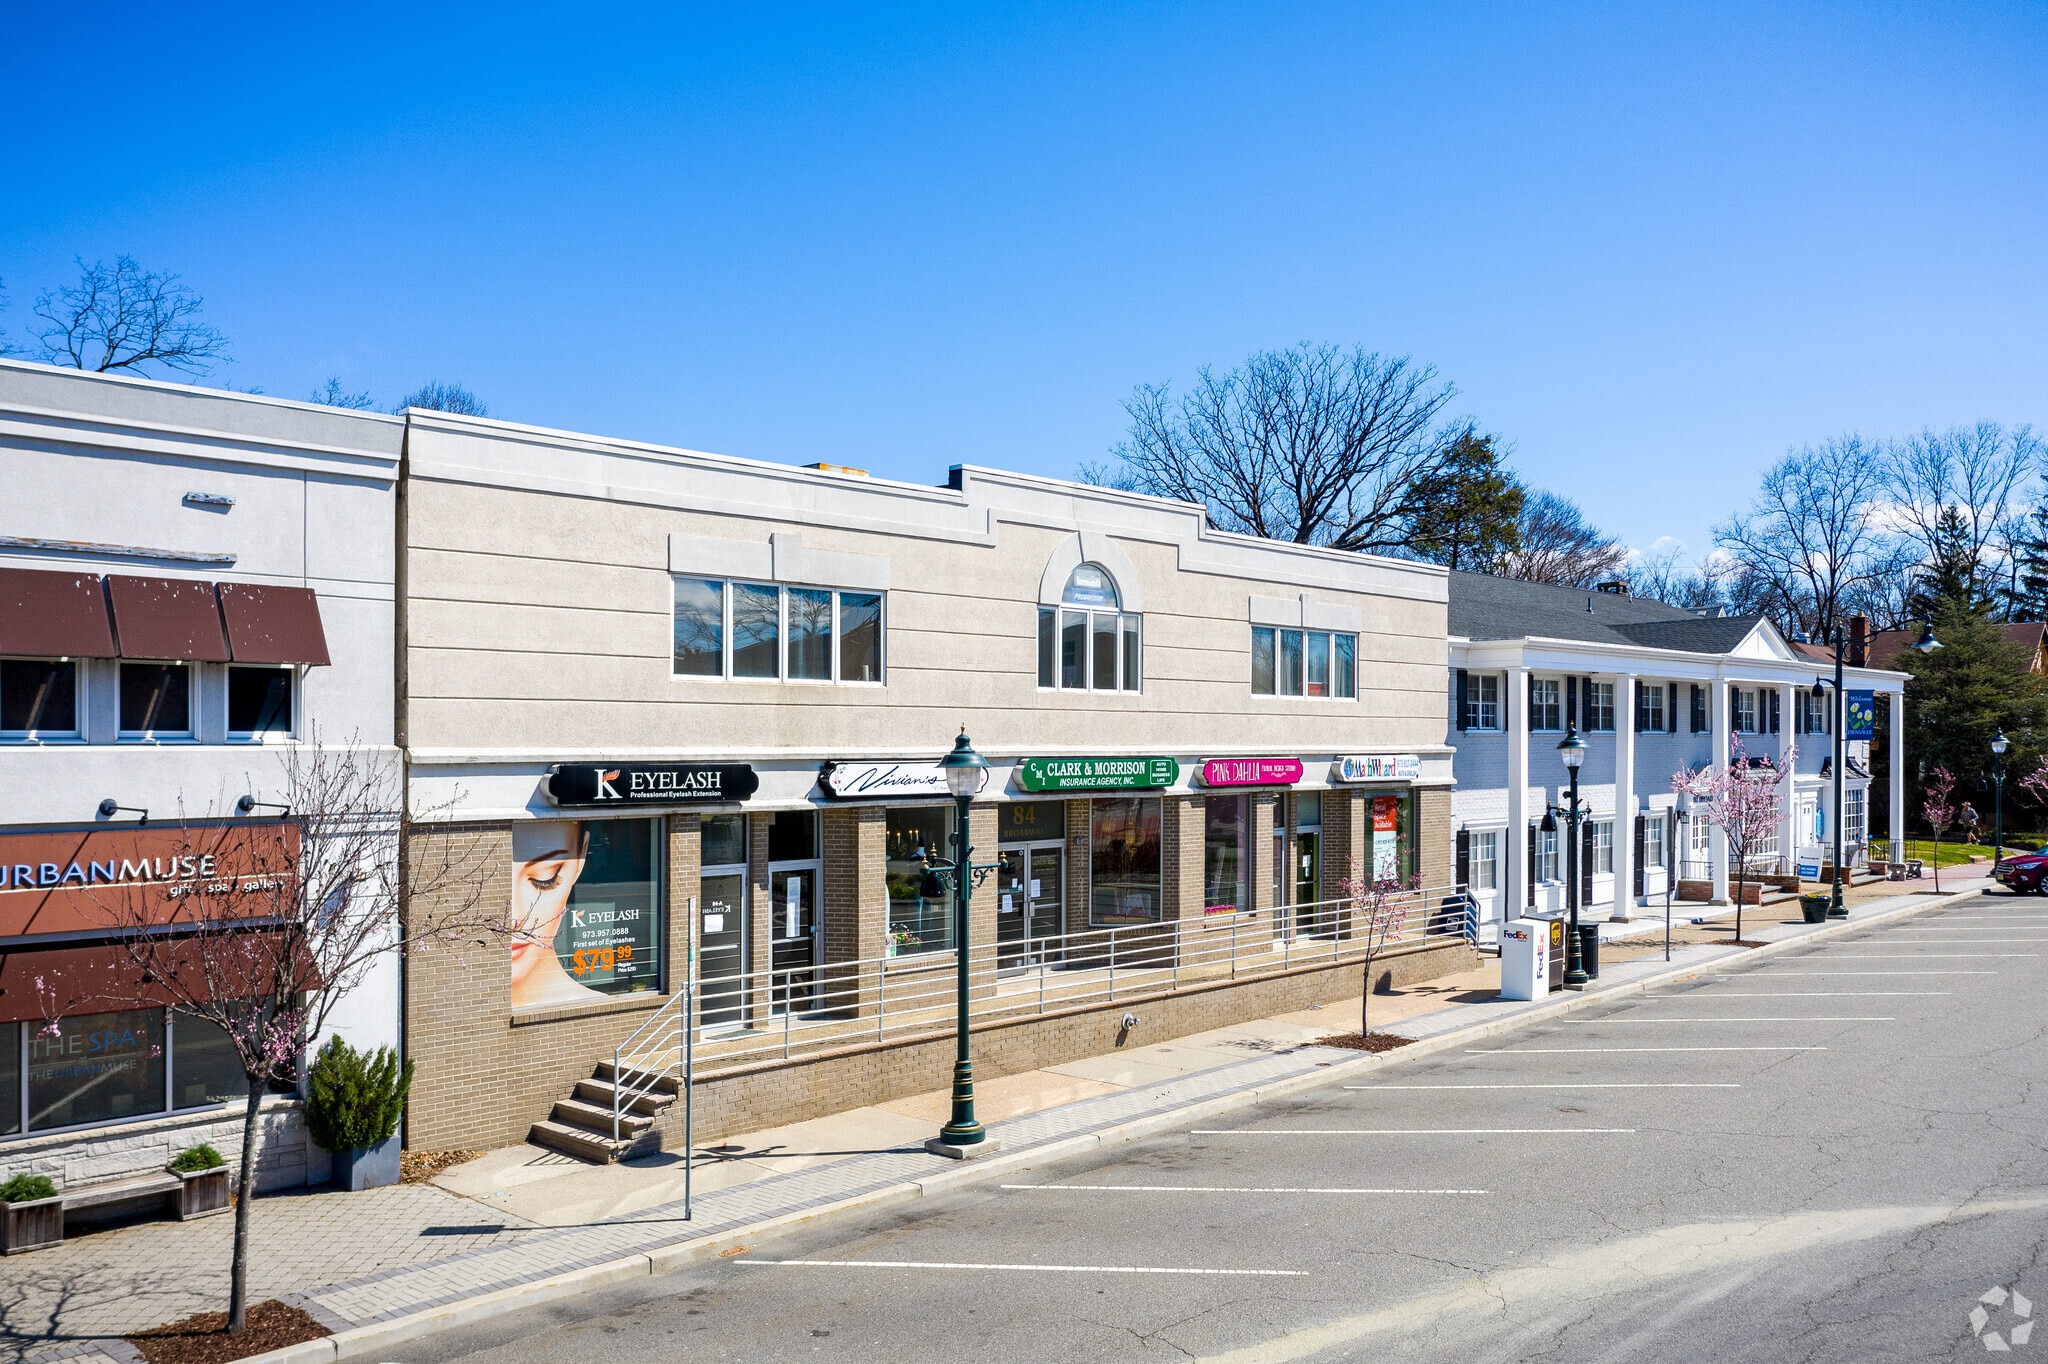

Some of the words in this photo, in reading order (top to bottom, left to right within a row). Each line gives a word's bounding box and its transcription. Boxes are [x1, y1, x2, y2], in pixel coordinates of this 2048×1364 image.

[1047, 762, 1081, 776] CLARK
[1084, 763, 1092, 775] &
[1095, 762, 1146, 775] MORRISON
[1212, 763, 1230, 782] PINK
[1232, 762, 1260, 781] DAHLIA
[594, 769, 622, 799] K
[630, 772, 722, 789] EYELASH
[844, 765, 947, 792] Vivian's
[1060, 778, 1097, 786] INSURANCE
[1097, 777, 1122, 787] AGENCY,
[1123, 777, 1135, 785] INC.
[669, 791, 692, 799] Eyelash
[1013, 805, 1036, 825] 84
[1375, 821, 1392, 829] Available
[1004, 828, 1044, 838] BROADWAY
[170, 884, 193, 897] gift
[570, 910, 586, 928] K
[588, 909, 640, 924] EYELASH
[582, 927, 629, 938] 973.957.0888
[1504, 930, 1528, 940] FedEx
[605, 936, 636, 946] Eyelashes
[573, 947, 614, 977] $79
[617, 945, 632, 958] 99
[28, 1034, 82, 1058] THE
[88, 1029, 137, 1053] SPA
